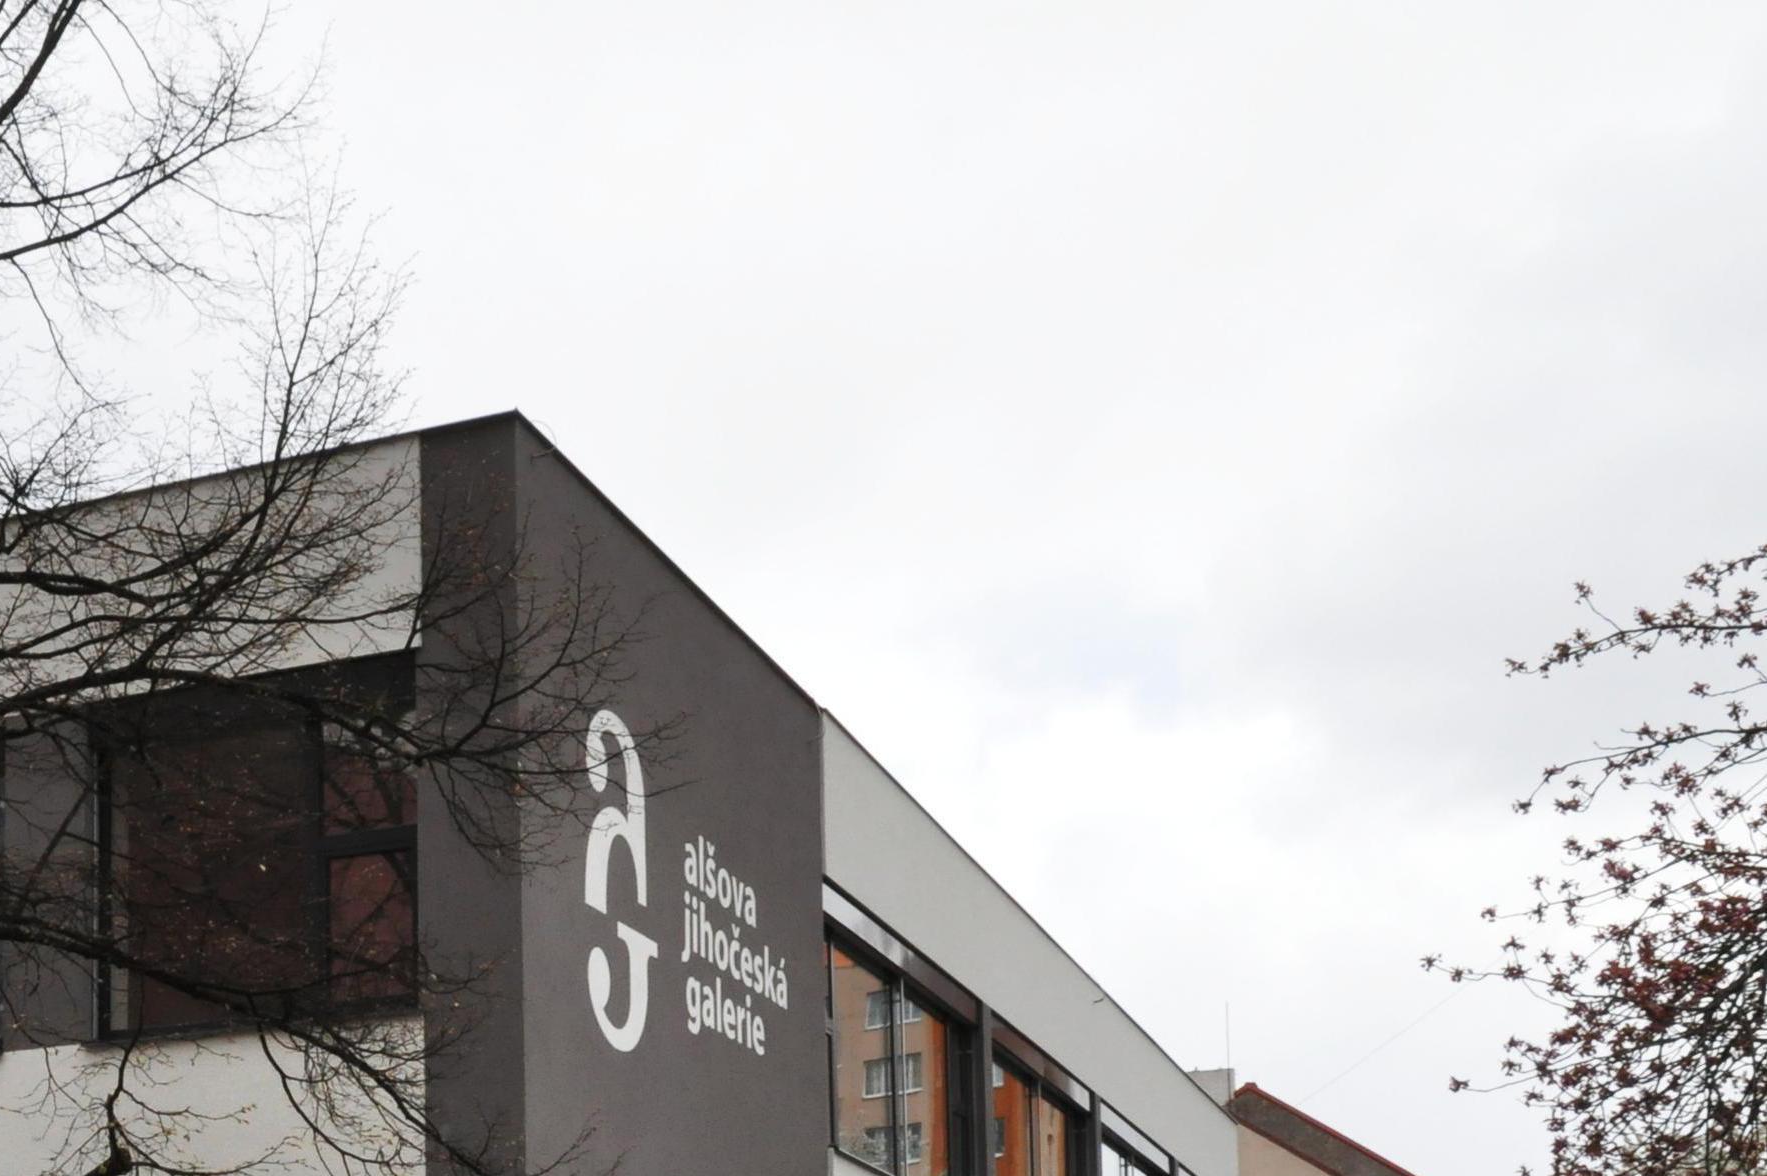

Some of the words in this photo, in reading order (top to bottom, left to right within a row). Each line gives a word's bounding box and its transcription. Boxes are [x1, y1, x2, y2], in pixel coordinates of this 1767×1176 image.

[684, 835, 757, 928] alšova
[681, 891, 788, 1010] jihočeská
[685, 976, 765, 1055] galerie
